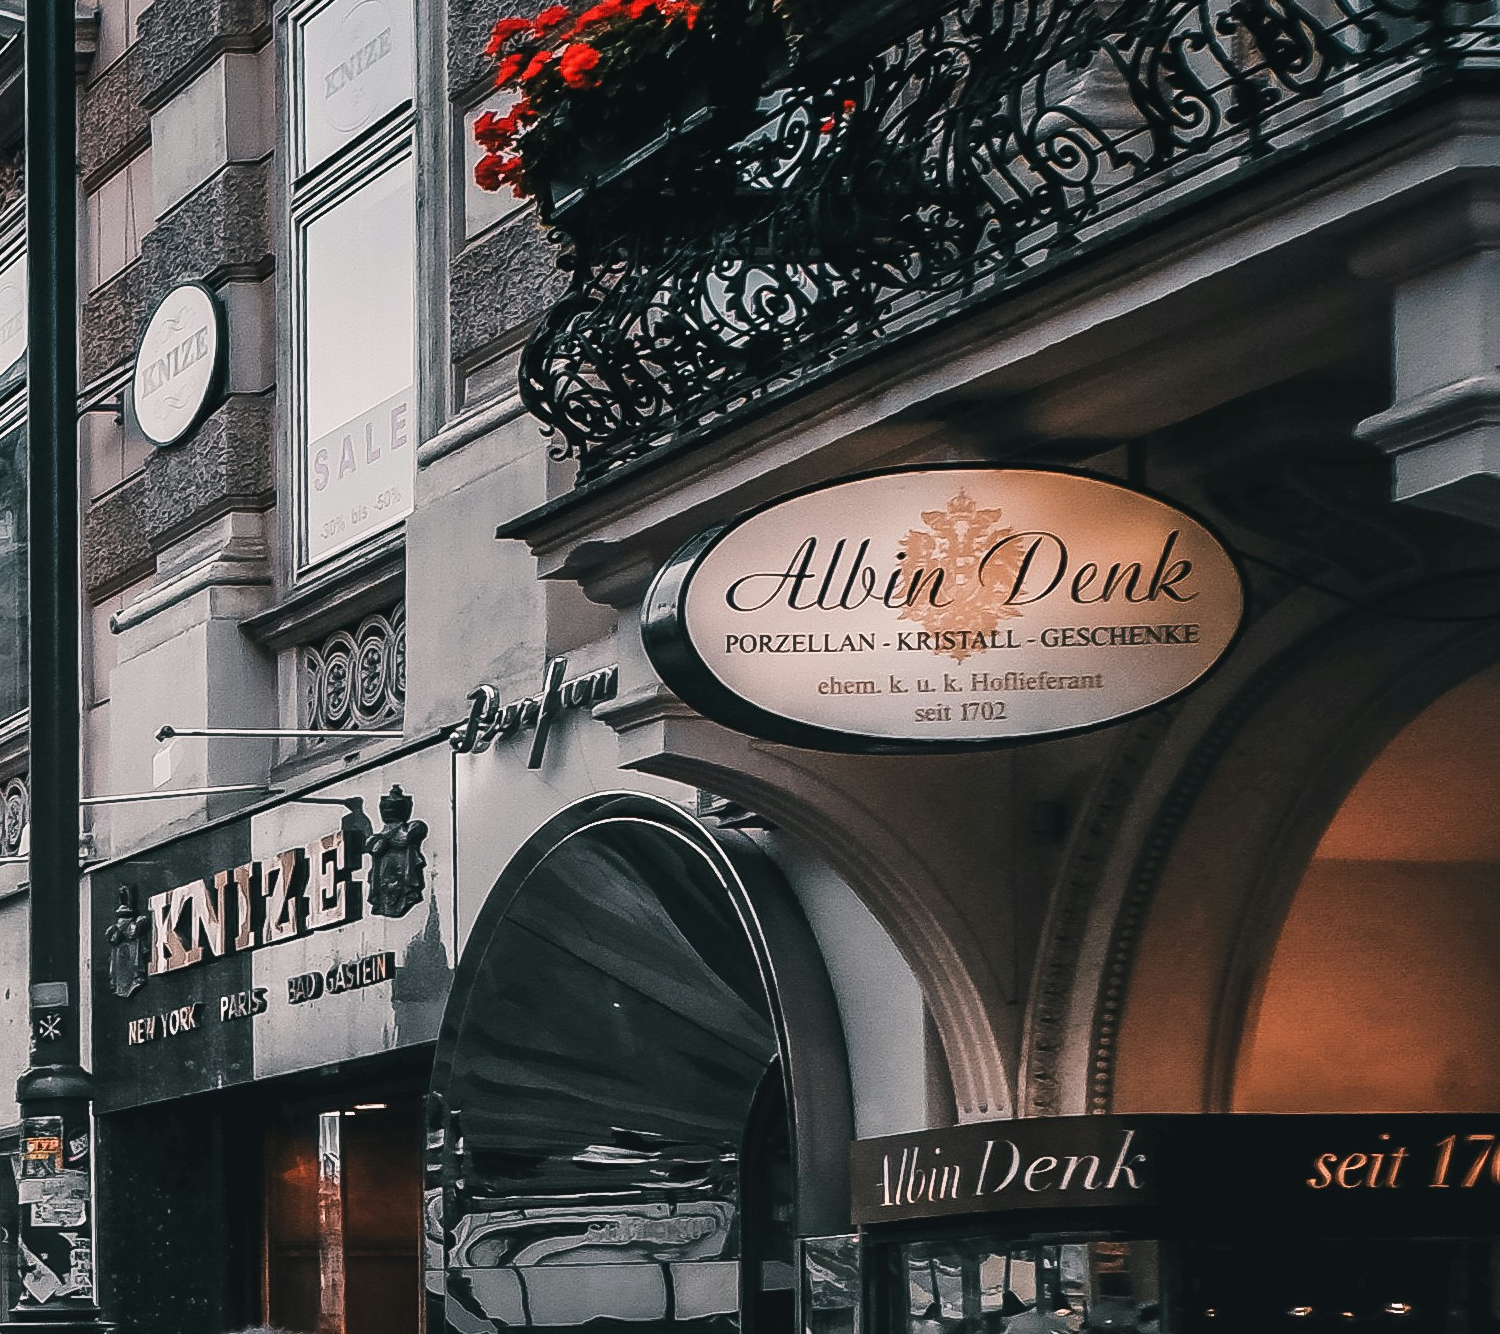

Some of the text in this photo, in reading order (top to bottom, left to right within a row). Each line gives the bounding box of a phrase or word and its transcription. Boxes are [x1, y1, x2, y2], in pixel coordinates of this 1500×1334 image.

[324, 26, 392, 100] KNIZE
[141, 324, 209, 400] KNIZE
[314, 403, 407, 492] SALE
[725, 530, 1199, 612] Albin Denk
[725, 632, 875, 654] PORZELLAN
[898, 628, 1021, 652] KRISTALL
[1041, 624, 1199, 648] GESCHENKE
[818, 670, 1104, 696] ehem. k. u. k. Hoflieferant
[915, 701, 1007, 722] seit 1702
[148, 830, 346, 976] KNIZE
[128, 952, 395, 1046] NEW YORK PARIS BAD GASTEIN
[877, 1145, 961, 1207] Albin
[975, 1129, 1147, 1197] Denk
[1306, 1133, 1410, 1190] seit
